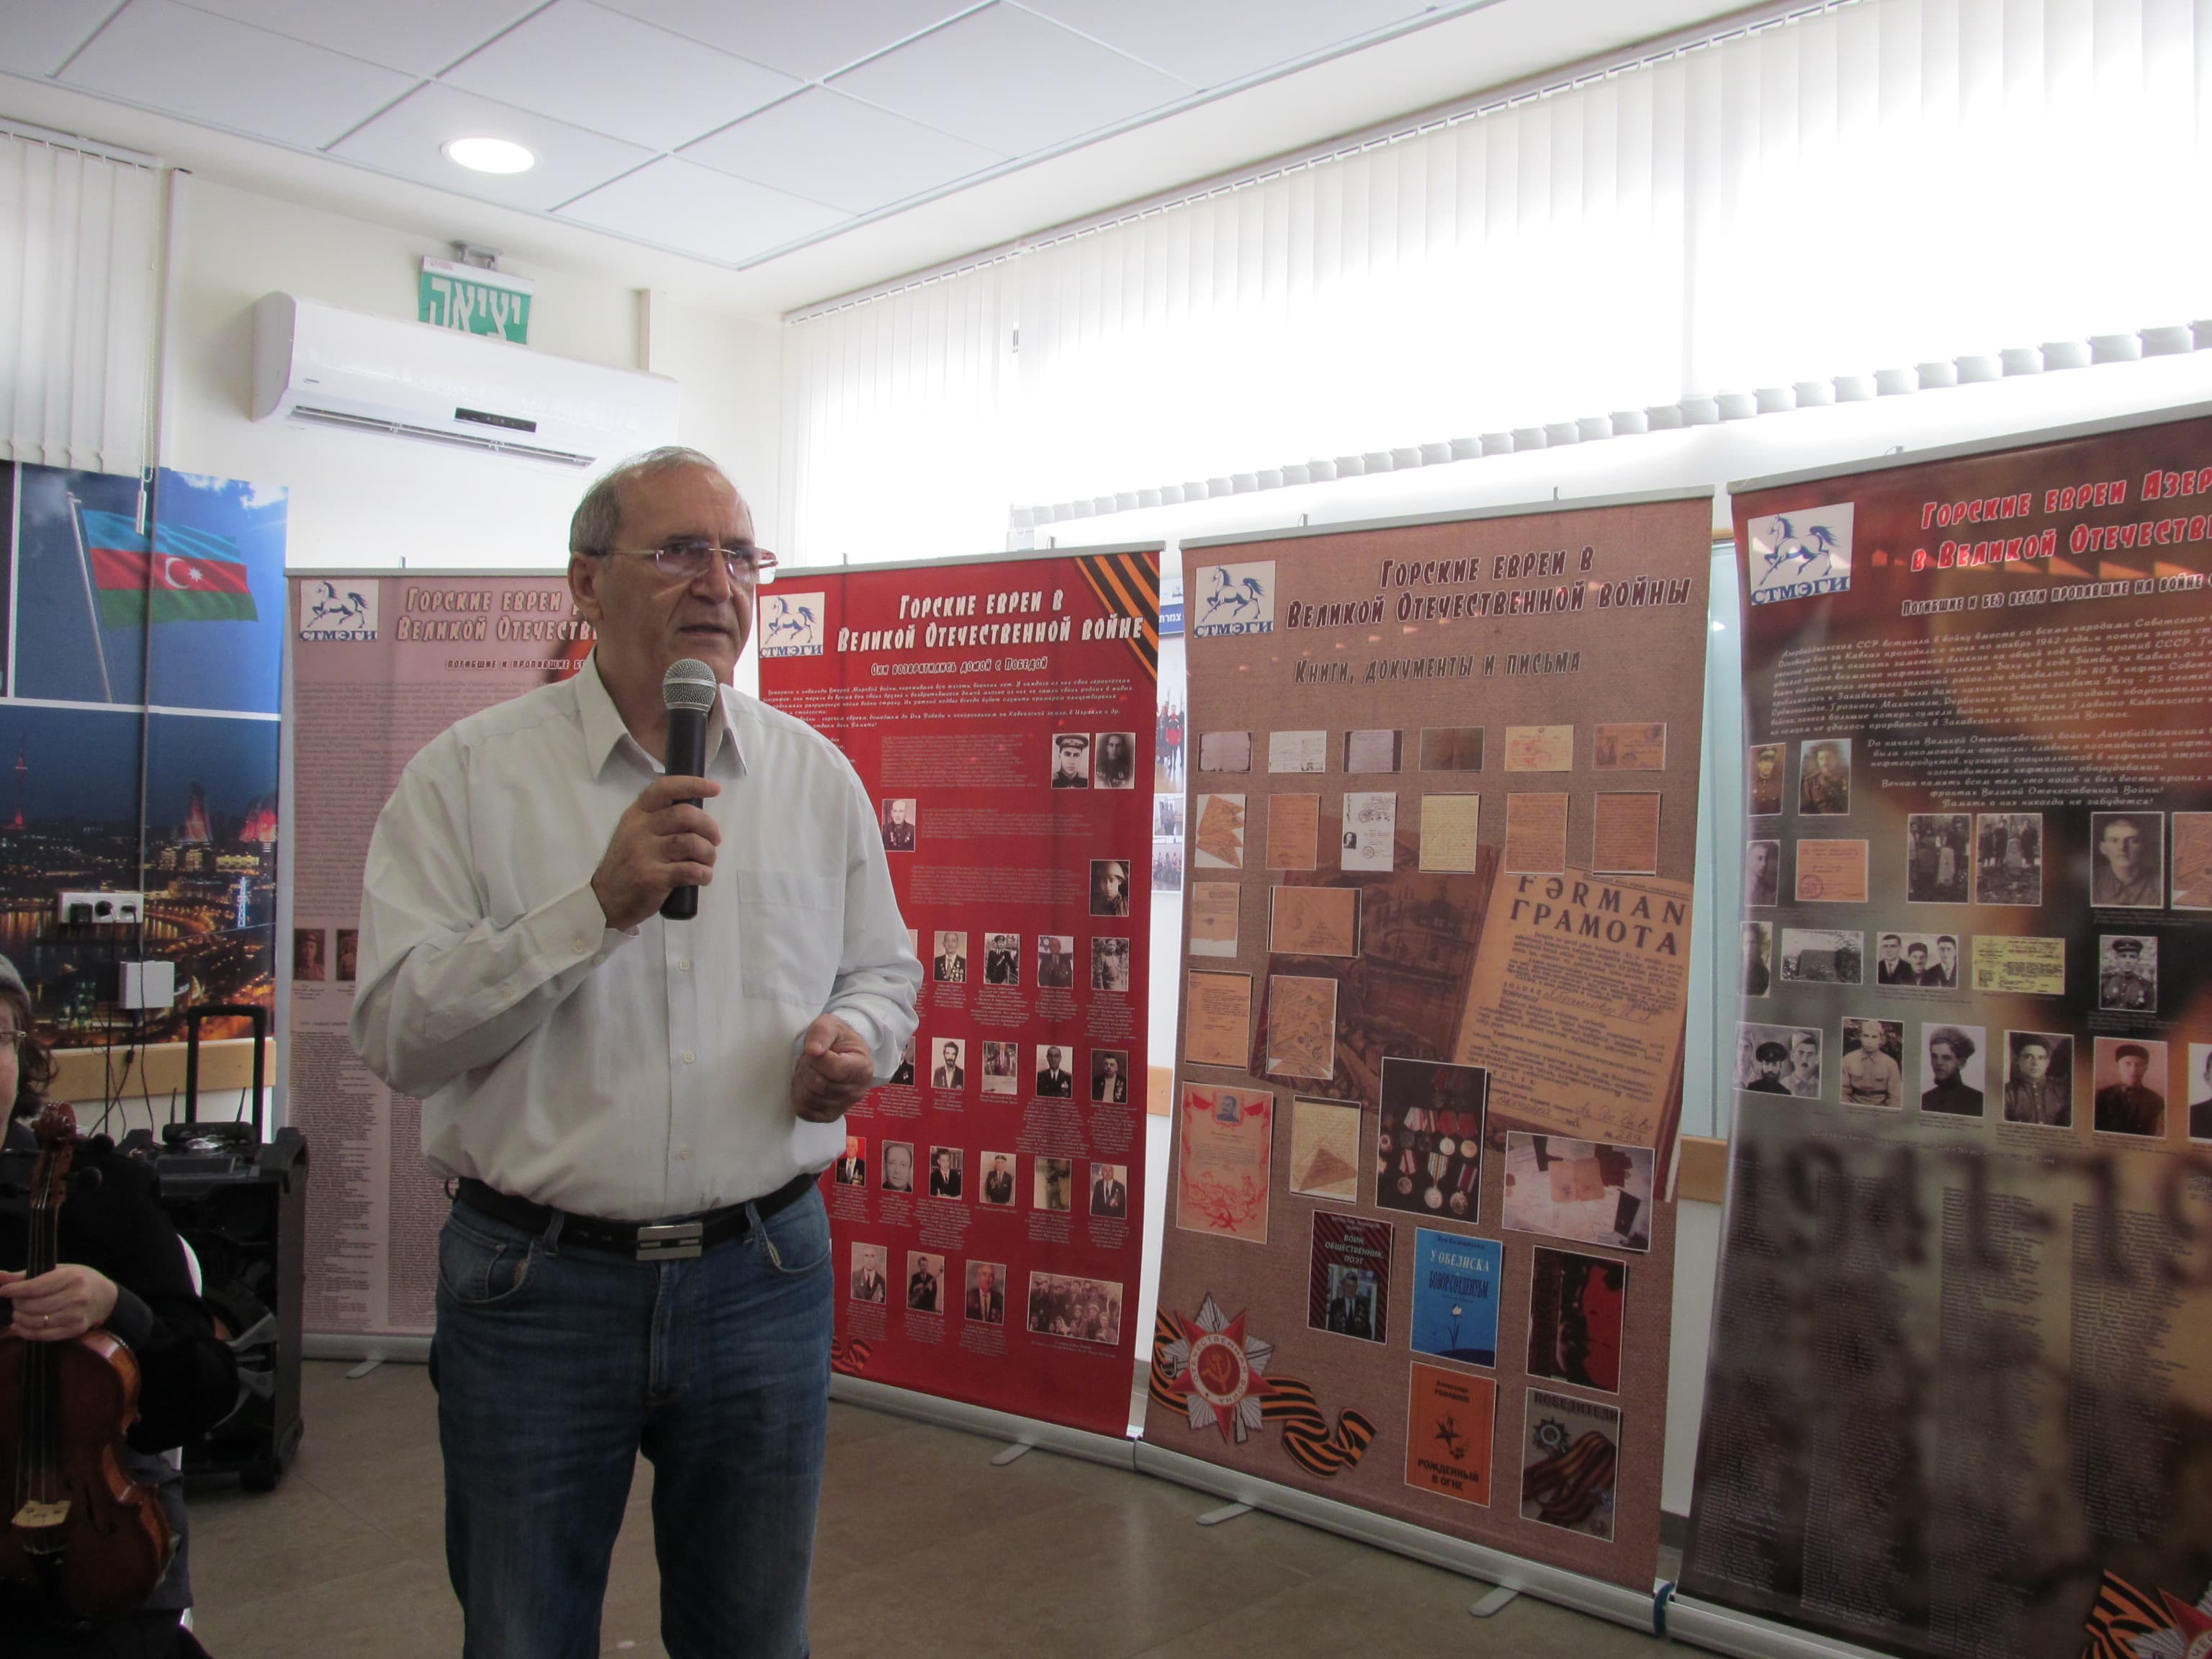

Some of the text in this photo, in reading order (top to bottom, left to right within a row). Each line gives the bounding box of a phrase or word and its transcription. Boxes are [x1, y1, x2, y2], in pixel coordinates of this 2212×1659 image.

[429, 277, 521, 341] יציאה
[1922, 467, 2212, 529] ГОРСКИЕ ЕВРЕИ АЗЕР
[1911, 549, 1925, 571] В
[1937, 529, 2056, 569] ВЕЛИКОЙ
[1380, 547, 1593, 588] ГОРСКИЕ ЕВРЕИ В
[407, 588, 562, 611] ГОРСКИЕ ЕВРЕИ
[900, 590, 1064, 619] ГОРСКИЕ ЕВРЕИ В
[1287, 577, 1692, 629] ВЕЛИКОЙ ОТЕЧЕСТВЕННОЙ ВОЙНЫ
[1750, 575, 1850, 605] СТМЭГИ
[1901, 574, 2202, 616] ПОГИБШИЕ И БЕЗ ВЕСТИ ПРОПАВШИЕ НА ВОЙНЕ
[300, 630, 377, 642] СТМЭГИ
[397, 616, 486, 642] ВЕЛИКОЙ
[837, 613, 1143, 651] ВЕЛИКОЙ ОТЕЧЕСТВЕННОЙ ВОЙНЕ
[1194, 621, 1273, 638] СТМЭГИ
[447, 660, 496, 669] ПОГИБШИЕ
[513, 660, 570, 669] ПРОПАВШИЕ
[760, 644, 822, 657] СТМЭГИ
[871, 662, 889, 675] ОНИ
[961, 660, 991, 673] ДОМОЙ
[995, 661, 1002, 670] С
[1005, 657, 1048, 670] ПОБЕДОЙ
[1364, 655, 1473, 685] ДОКУМЕНТЫ
[1483, 655, 1495, 675] И
[1506, 651, 1581, 675] ПИСЬМА
[1510, 898, 1676, 956] ГРАМОТА
[1344, 1256, 1364, 1265] ПОЭТ
[1431, 1249, 1491, 1272] У ОБЕЛИСКА
